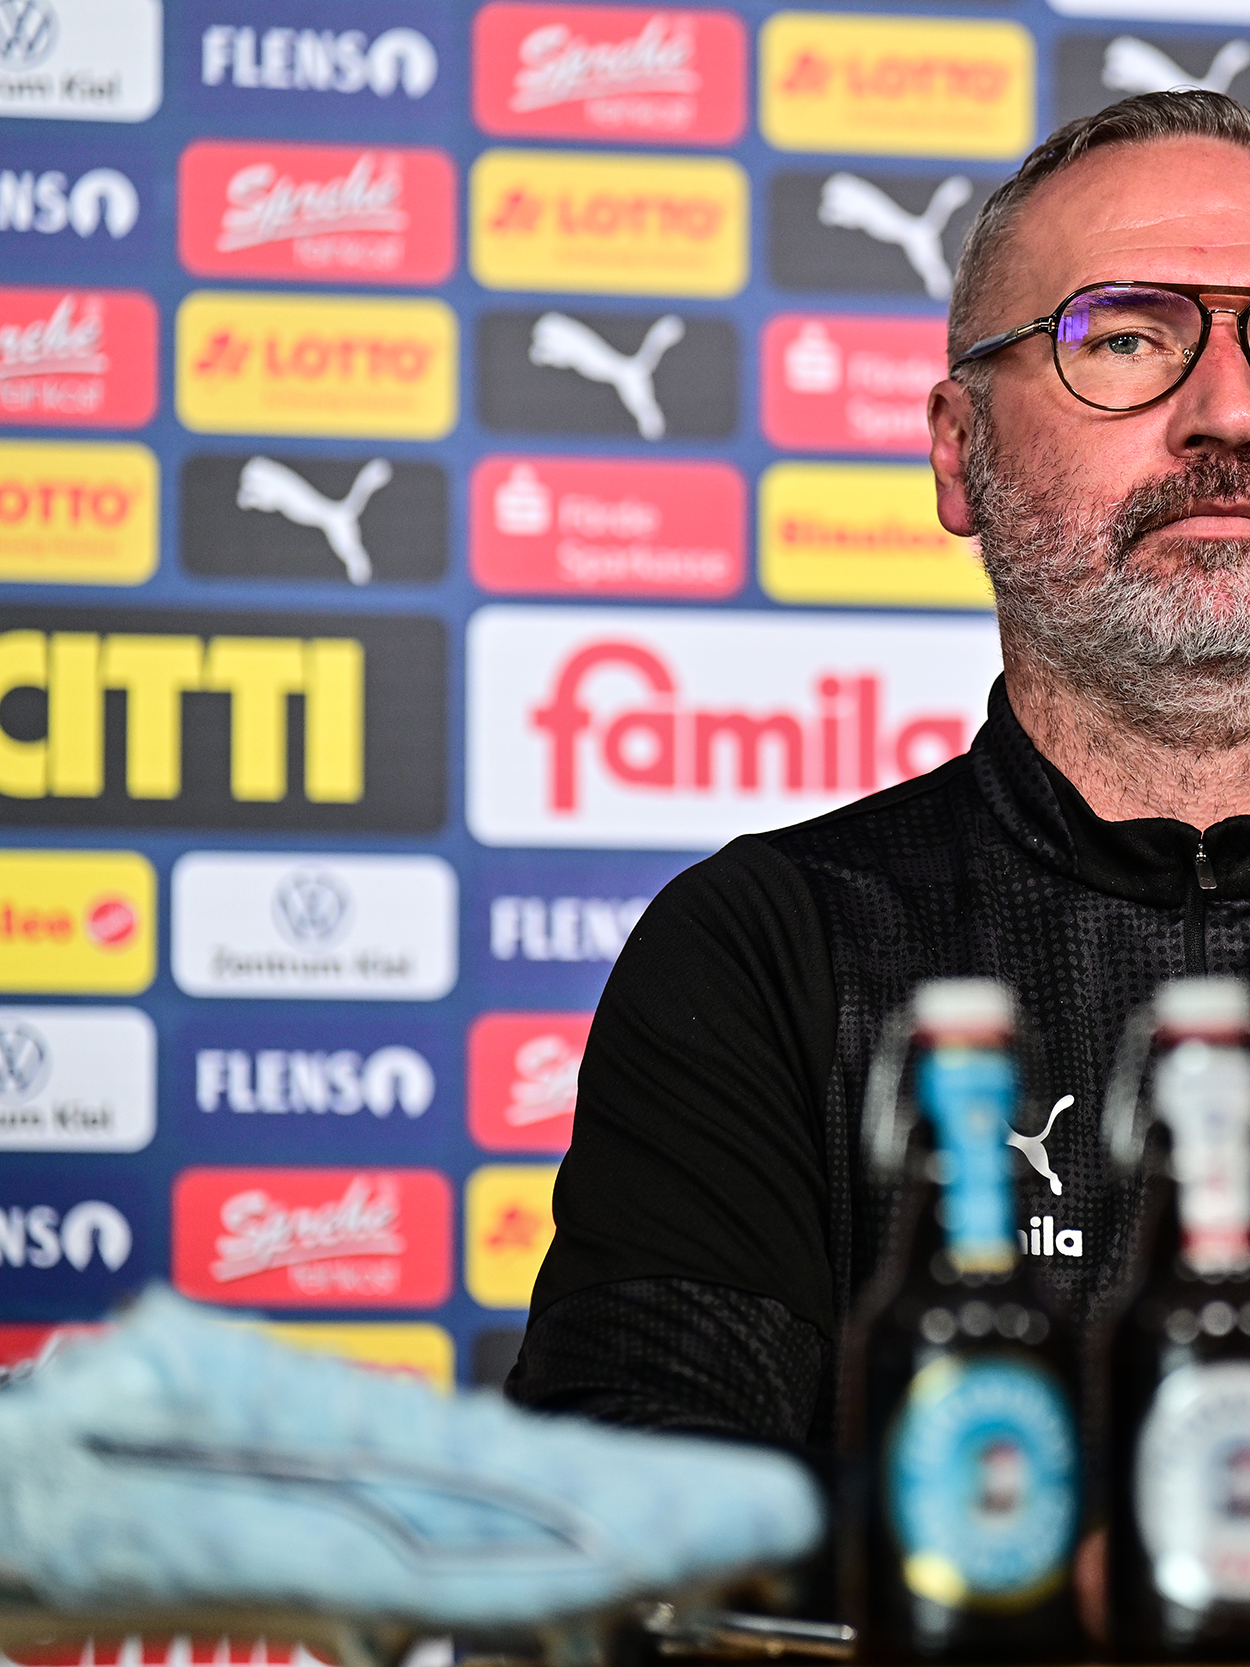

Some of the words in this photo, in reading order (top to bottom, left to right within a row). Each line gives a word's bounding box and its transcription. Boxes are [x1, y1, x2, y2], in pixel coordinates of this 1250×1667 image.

[263, 332, 436, 385] LOTTO
[0, 479, 135, 529] OTTO
[531, 638, 970, 815] famila
